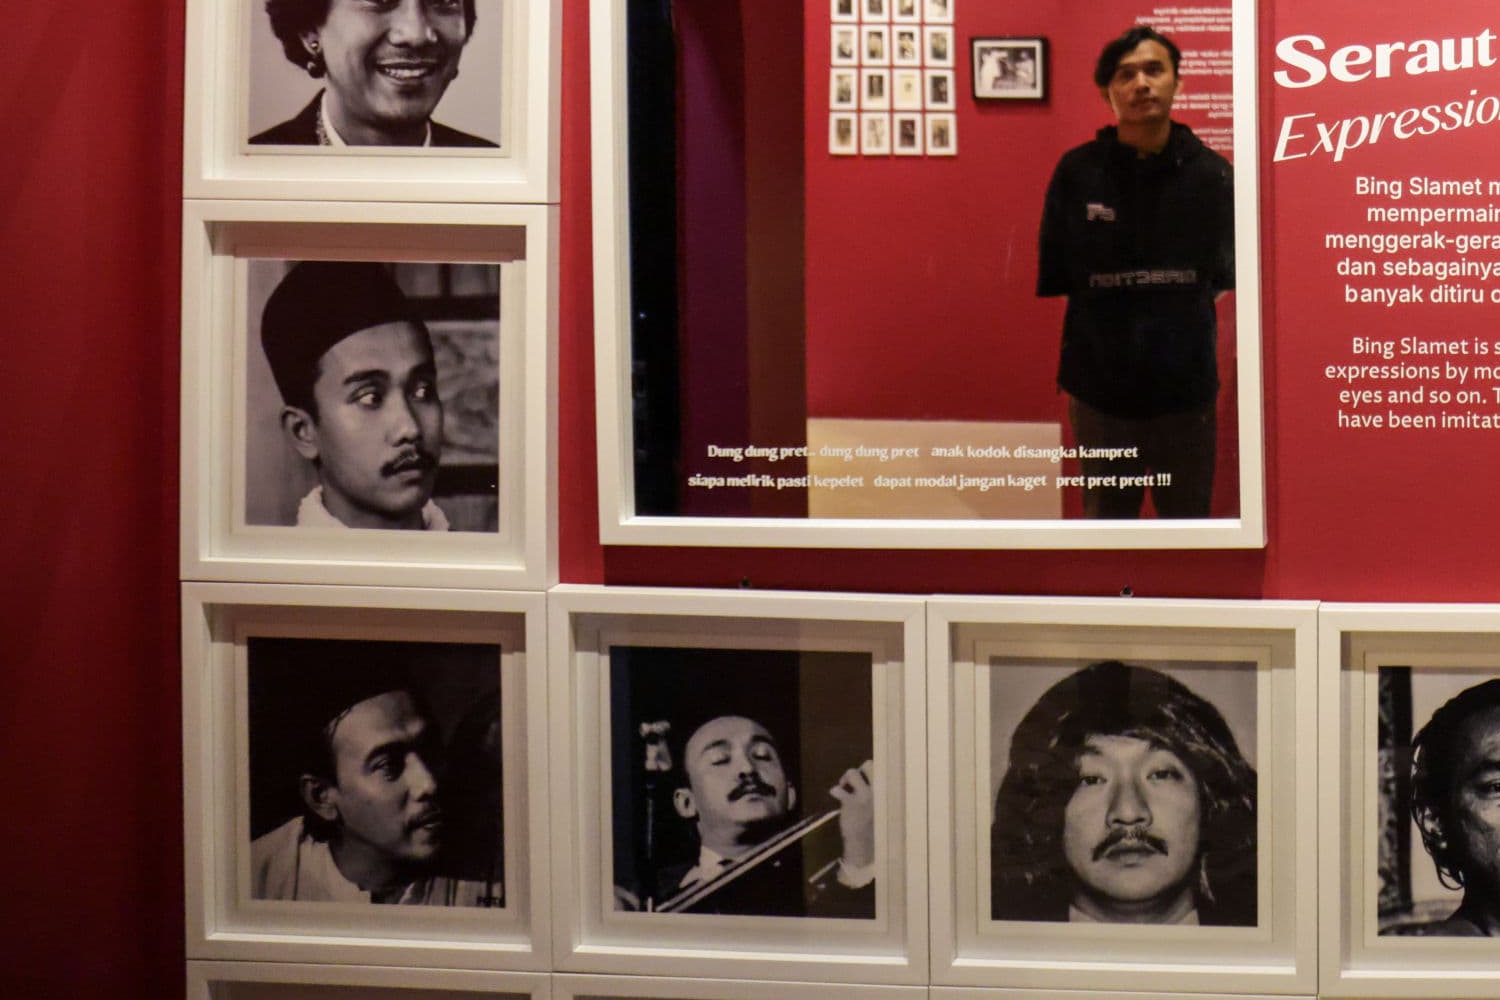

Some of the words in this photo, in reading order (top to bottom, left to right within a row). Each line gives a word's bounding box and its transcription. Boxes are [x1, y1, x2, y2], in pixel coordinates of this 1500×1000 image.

[1273, 28, 1498, 89] Seraut
[1355, 176, 1403, 200] Bing
[1409, 176, 1483, 196] Slamet
[1336, 256, 1376, 276] dan
[1345, 283, 1424, 308] banyak
[1430, 283, 1484, 303] ditiru
[1352, 336, 1396, 360] Bing
[1400, 336, 1469, 355] Slamet
[1474, 336, 1489, 355] is
[1324, 361, 1441, 384] expressions
[1445, 360, 1469, 385] by
[1339, 390, 1383, 409] eyes
[1387, 385, 1424, 404] and
[1429, 390, 1451, 404] so
[1456, 390, 1487, 404] on.
[1338, 409, 1384, 428] have
[1388, 409, 1436, 429] been
[707, 444, 743, 462] Dung
[744, 445, 778, 462] dung
[820, 445, 854, 462] dung
[855, 445, 889, 462] dung
[890, 446, 919, 462] pret
[931, 445, 964, 458] anak
[967, 446, 1011, 458] kodok
[1013, 446, 1077, 463] disangka
[1078, 446, 1138, 462] kampret
[688, 473, 725, 489] siapa
[726, 474, 776, 487] melirik
[777, 475, 811, 490] pasti
[874, 475, 913, 490] dapat
[915, 475, 957, 487] modal
[957, 474, 1005, 491] jangan
[1007, 474, 1047, 491] kaget
[1055, 475, 1085, 489] pret
[1087, 475, 1117, 490] pret
[1156, 473, 1172, 487] !!!
